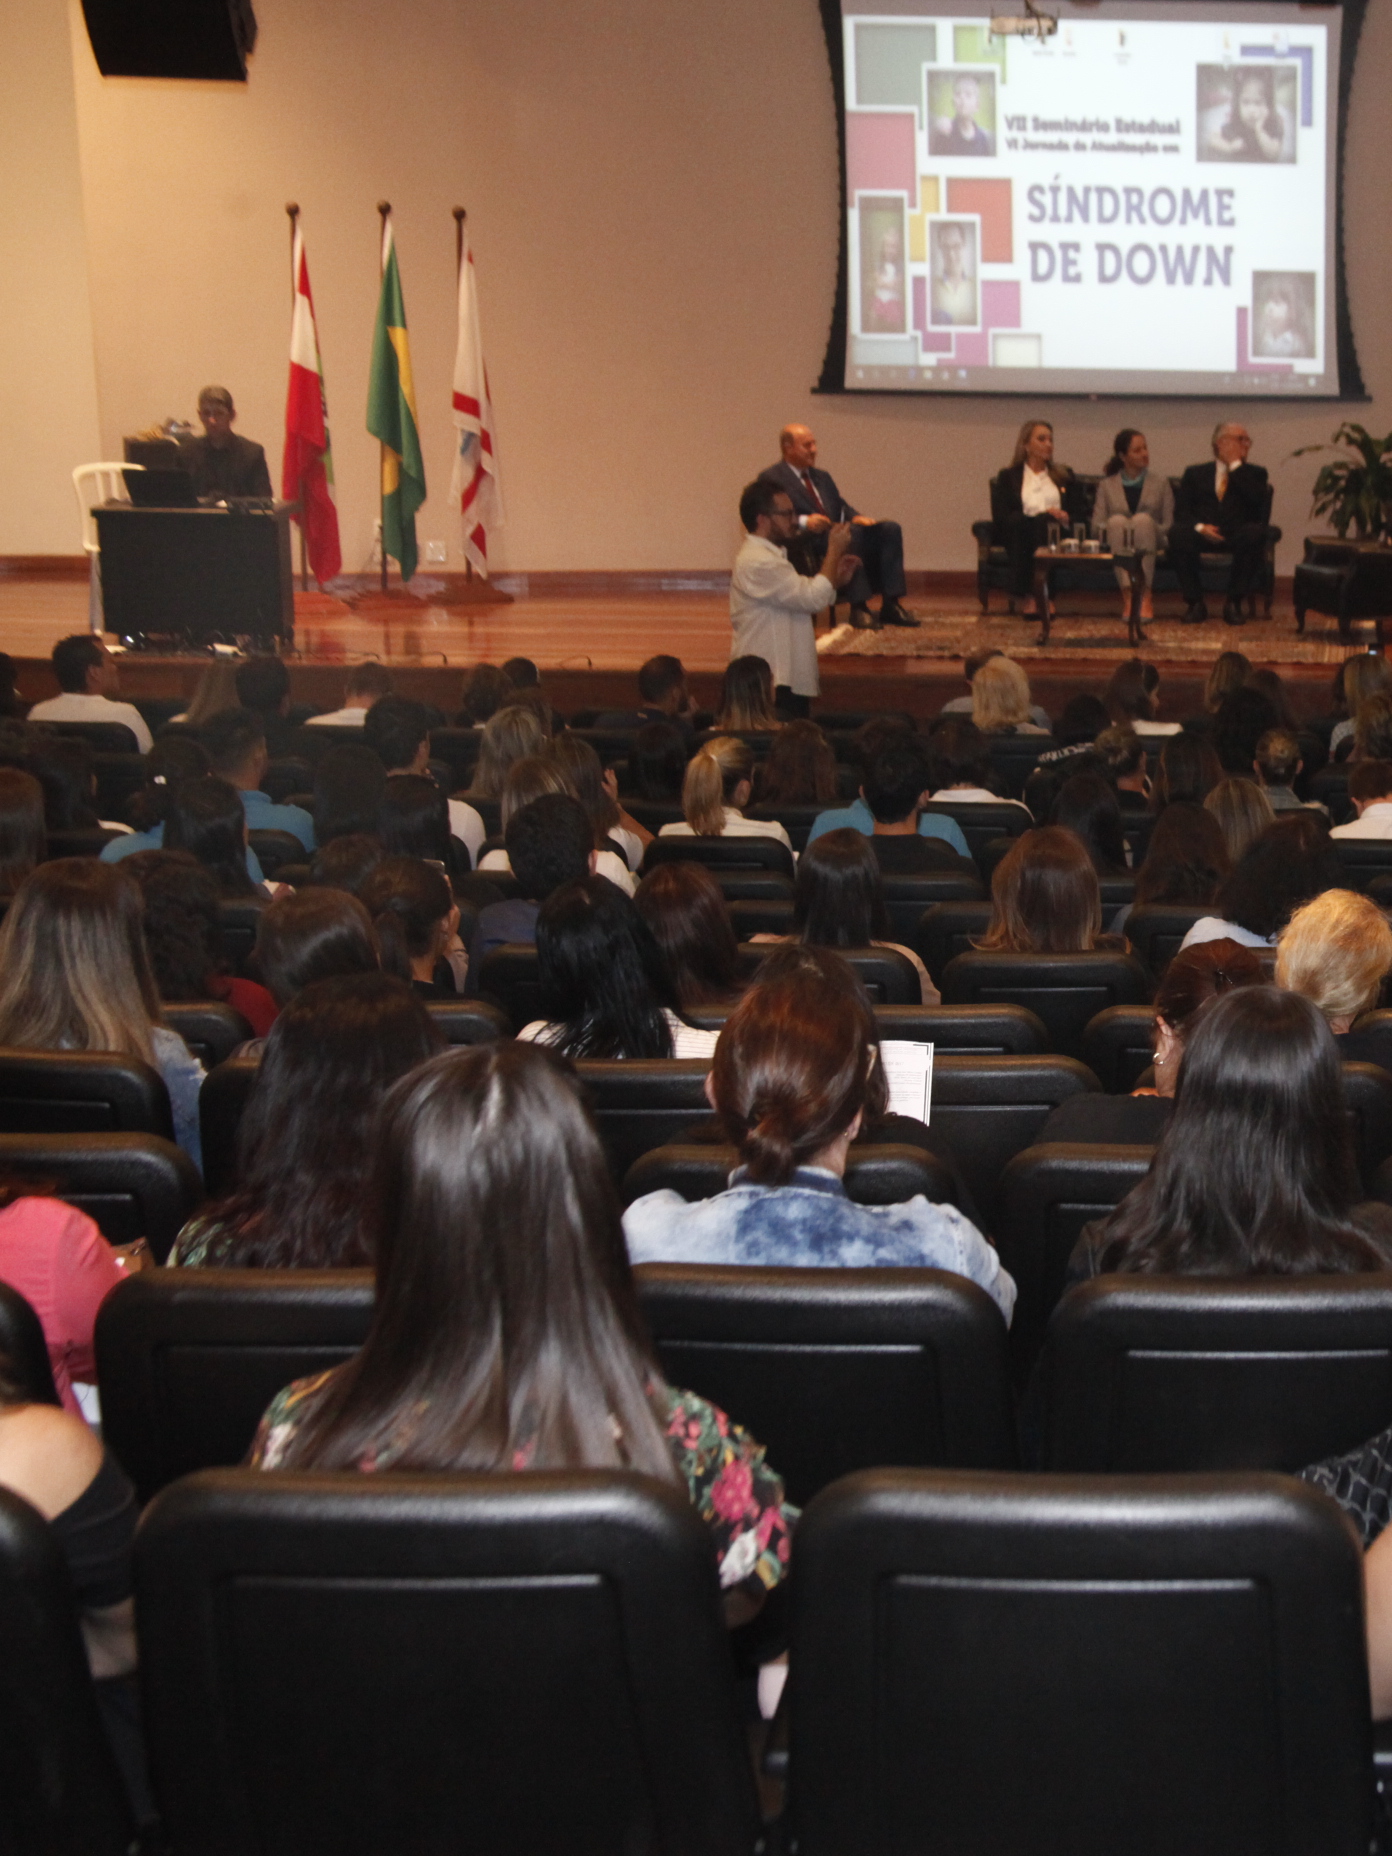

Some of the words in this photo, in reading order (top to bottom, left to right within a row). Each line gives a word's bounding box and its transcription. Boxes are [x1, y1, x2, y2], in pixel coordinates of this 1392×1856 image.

[1114, 117, 1181, 135] Estadual
[1027, 173, 1236, 226] SÍNDROME
[1027, 241, 1083, 284] DE
[1094, 242, 1234, 286] DOWN
